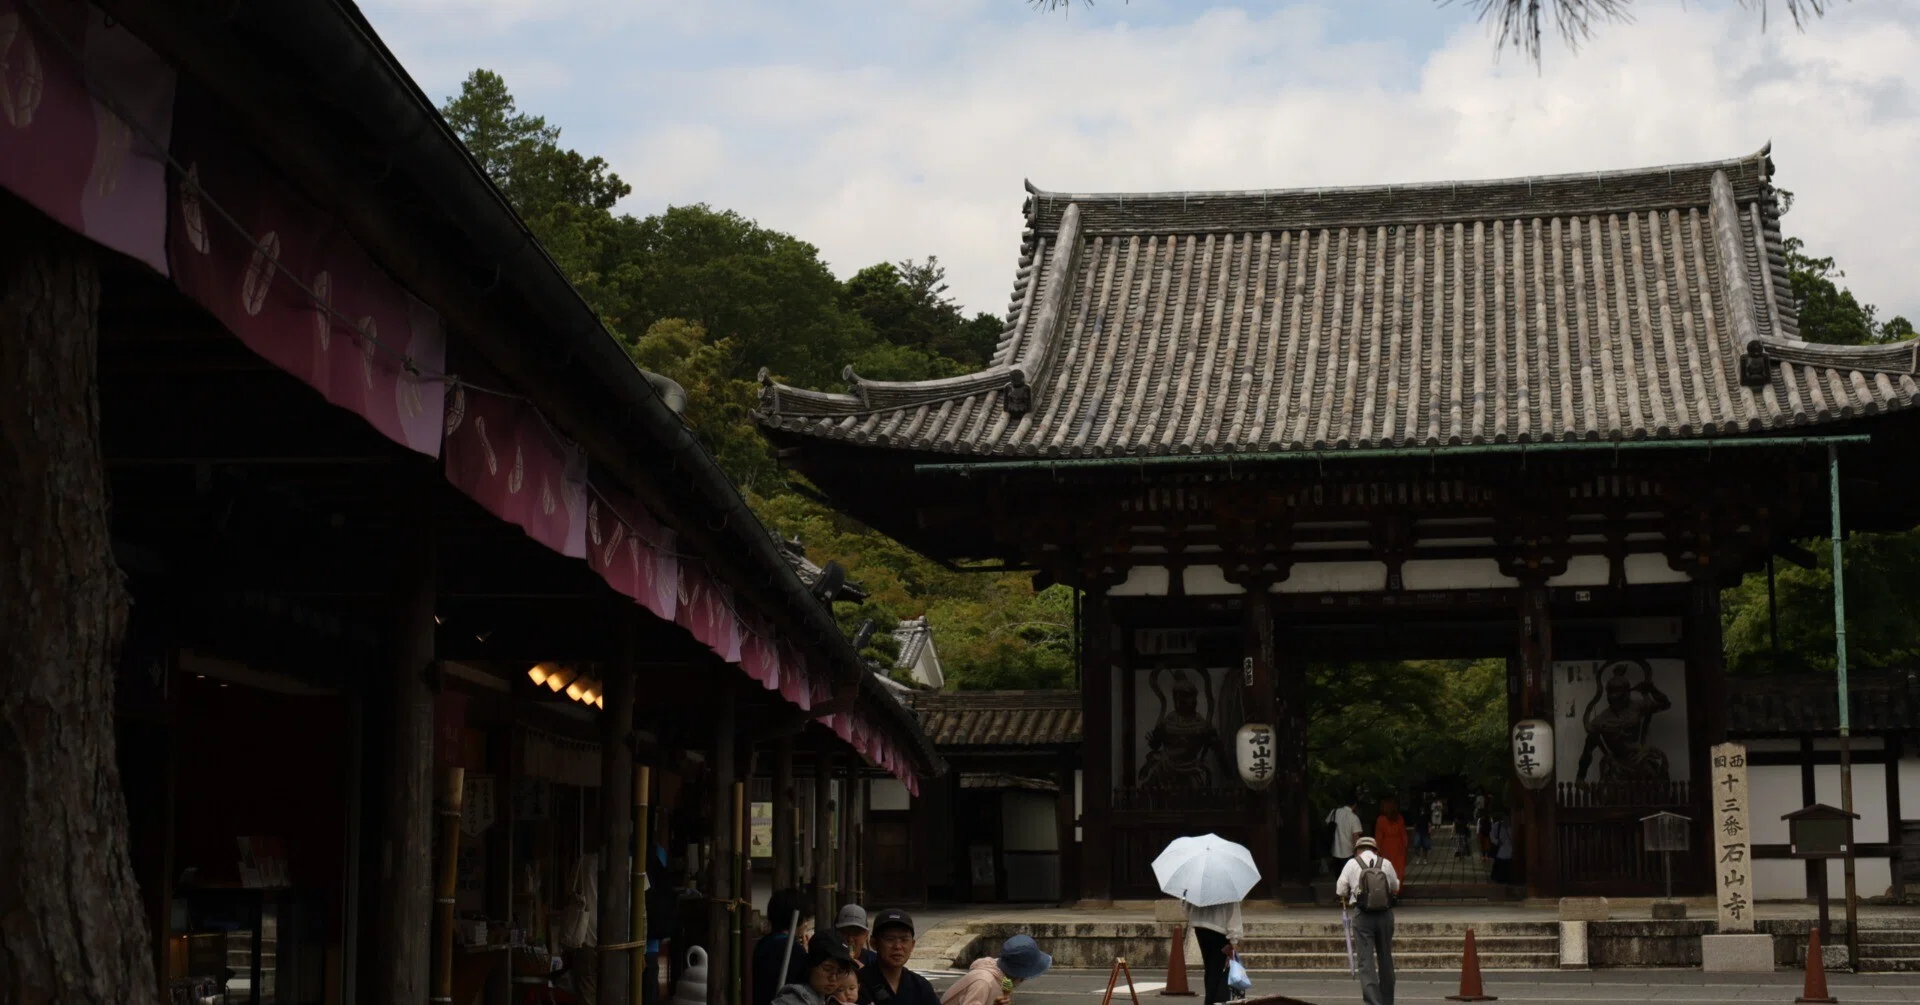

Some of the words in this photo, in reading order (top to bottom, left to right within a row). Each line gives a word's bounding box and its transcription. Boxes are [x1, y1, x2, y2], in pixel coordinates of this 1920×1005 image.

[1249, 728, 1273, 779] 石山寺
[1515, 724, 1540, 776] 石山寺
